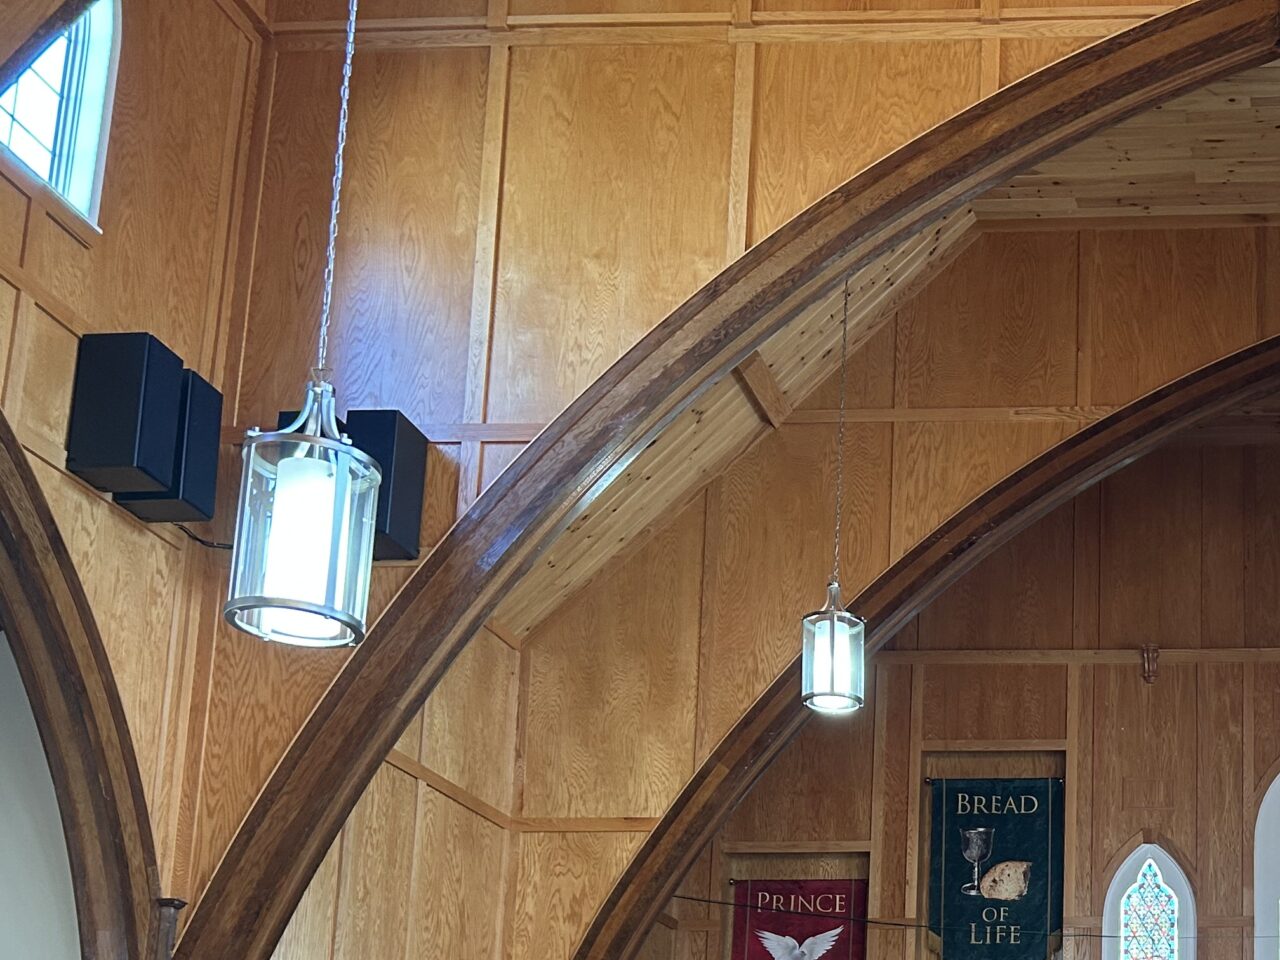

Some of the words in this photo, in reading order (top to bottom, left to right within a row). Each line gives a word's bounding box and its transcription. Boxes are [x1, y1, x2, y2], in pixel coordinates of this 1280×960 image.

[957, 793, 1038, 814] BREAD
[757, 892, 846, 913] PRINCE
[982, 907, 1009, 923] OF
[969, 922, 1021, 944] LIFE
